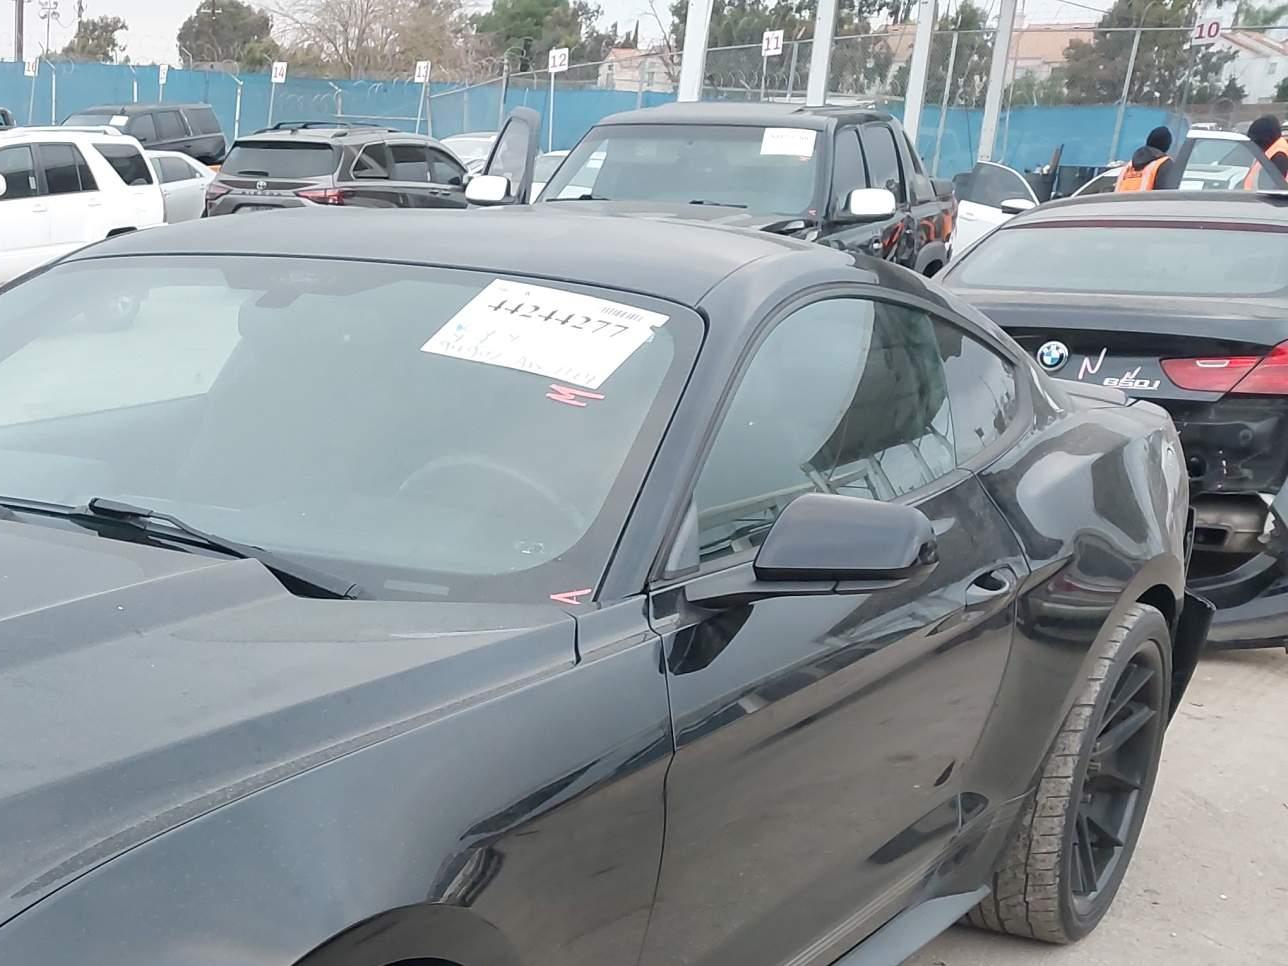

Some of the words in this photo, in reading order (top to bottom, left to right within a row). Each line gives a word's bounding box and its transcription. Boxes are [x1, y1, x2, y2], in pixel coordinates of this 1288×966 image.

[1194, 21, 1220, 39] 10
[764, 35, 781, 51] 11
[550, 52, 567, 69] 12
[273, 66, 285, 79] 14
[488, 299, 630, 338] 44244277
